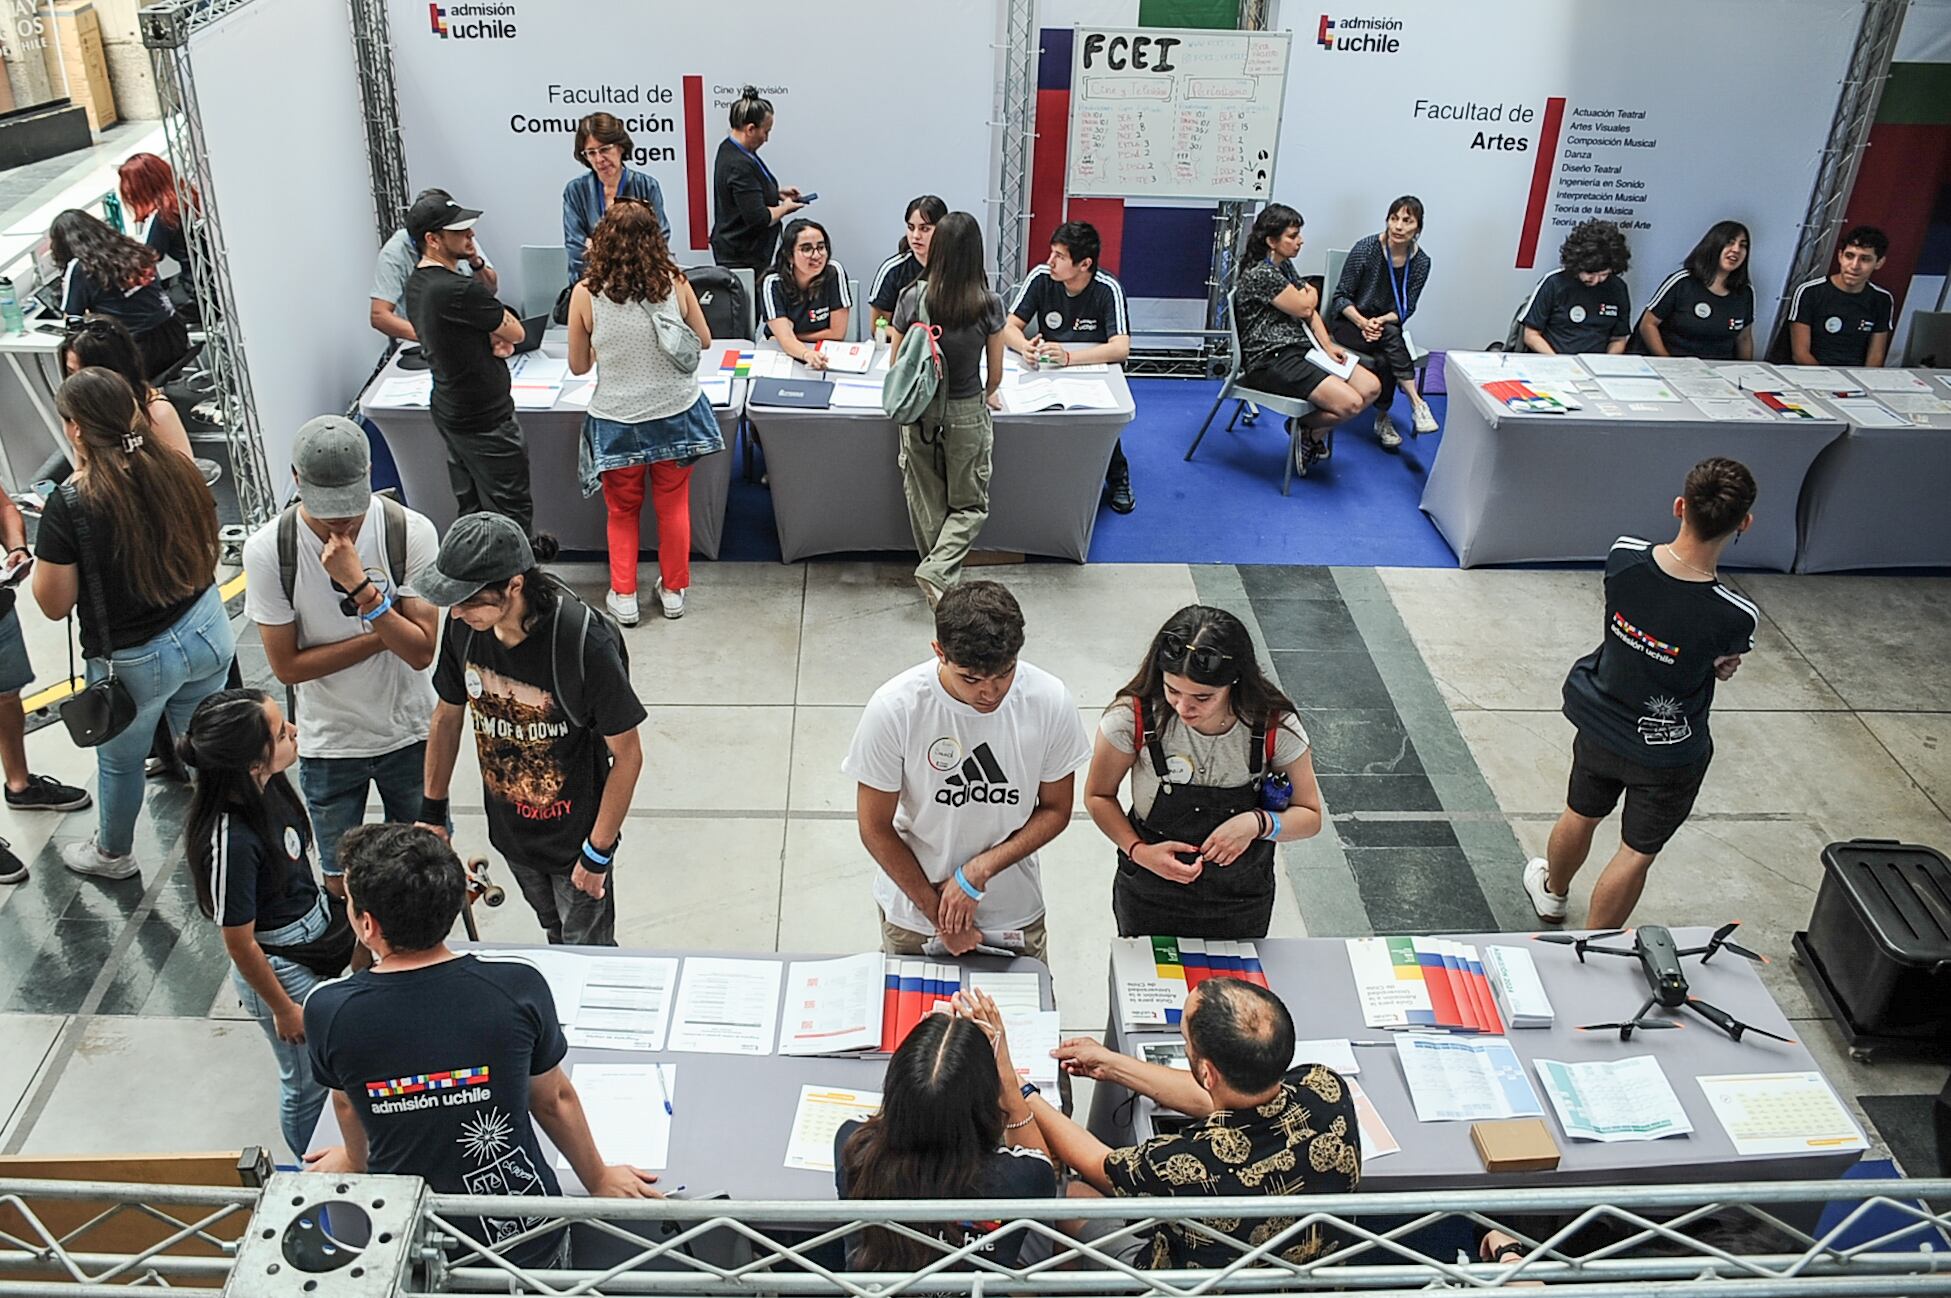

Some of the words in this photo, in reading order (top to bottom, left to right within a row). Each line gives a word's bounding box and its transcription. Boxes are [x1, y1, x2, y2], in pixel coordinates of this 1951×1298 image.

[451, 2, 515, 16] admisión
[452, 19, 517, 39] uchile
[1340, 16, 1403, 31] admisión
[1337, 33, 1400, 53] uchile
[1083, 34, 1181, 72] FCEI
[548, 84, 640, 104] Facultad
[646, 84, 673, 104] de
[713, 86, 734, 95] Cine
[1414, 99, 1503, 121] Facultad
[1508, 104, 1534, 123] de
[1572, 108, 1614, 118] Actuación
[1617, 109, 1646, 119] Teatral
[1569, 122, 1592, 131] Artes
[1595, 123, 1631, 133] Visuales
[1470, 131, 1529, 151] Artes
[1567, 136, 1622, 147] Composición
[1623, 138, 1657, 148] Musical
[1564, 149, 1592, 159] Danza
[1562, 164, 1591, 173] Diseño
[1594, 165, 1622, 174] Teatral
[1615, 179, 1645, 189] Sonido
[1556, 191, 1613, 201] Interpretación
[1615, 193, 1648, 202] Musical
[1581, 206, 1592, 214] de
[1594, 206, 1602, 214] la
[1619, 221, 1633, 229] del
[1633, 222, 1652, 230] Arte
[1611, 624, 1645, 652] admisión
[1645, 648, 1675, 665] uchile
[528, 721, 569, 741] DOWN
[935, 783, 1020, 807] adidas
[515, 800, 574, 821] TOXICITY
[371, 1094, 439, 1114] admisión
[442, 1087, 491, 1106] uchile
